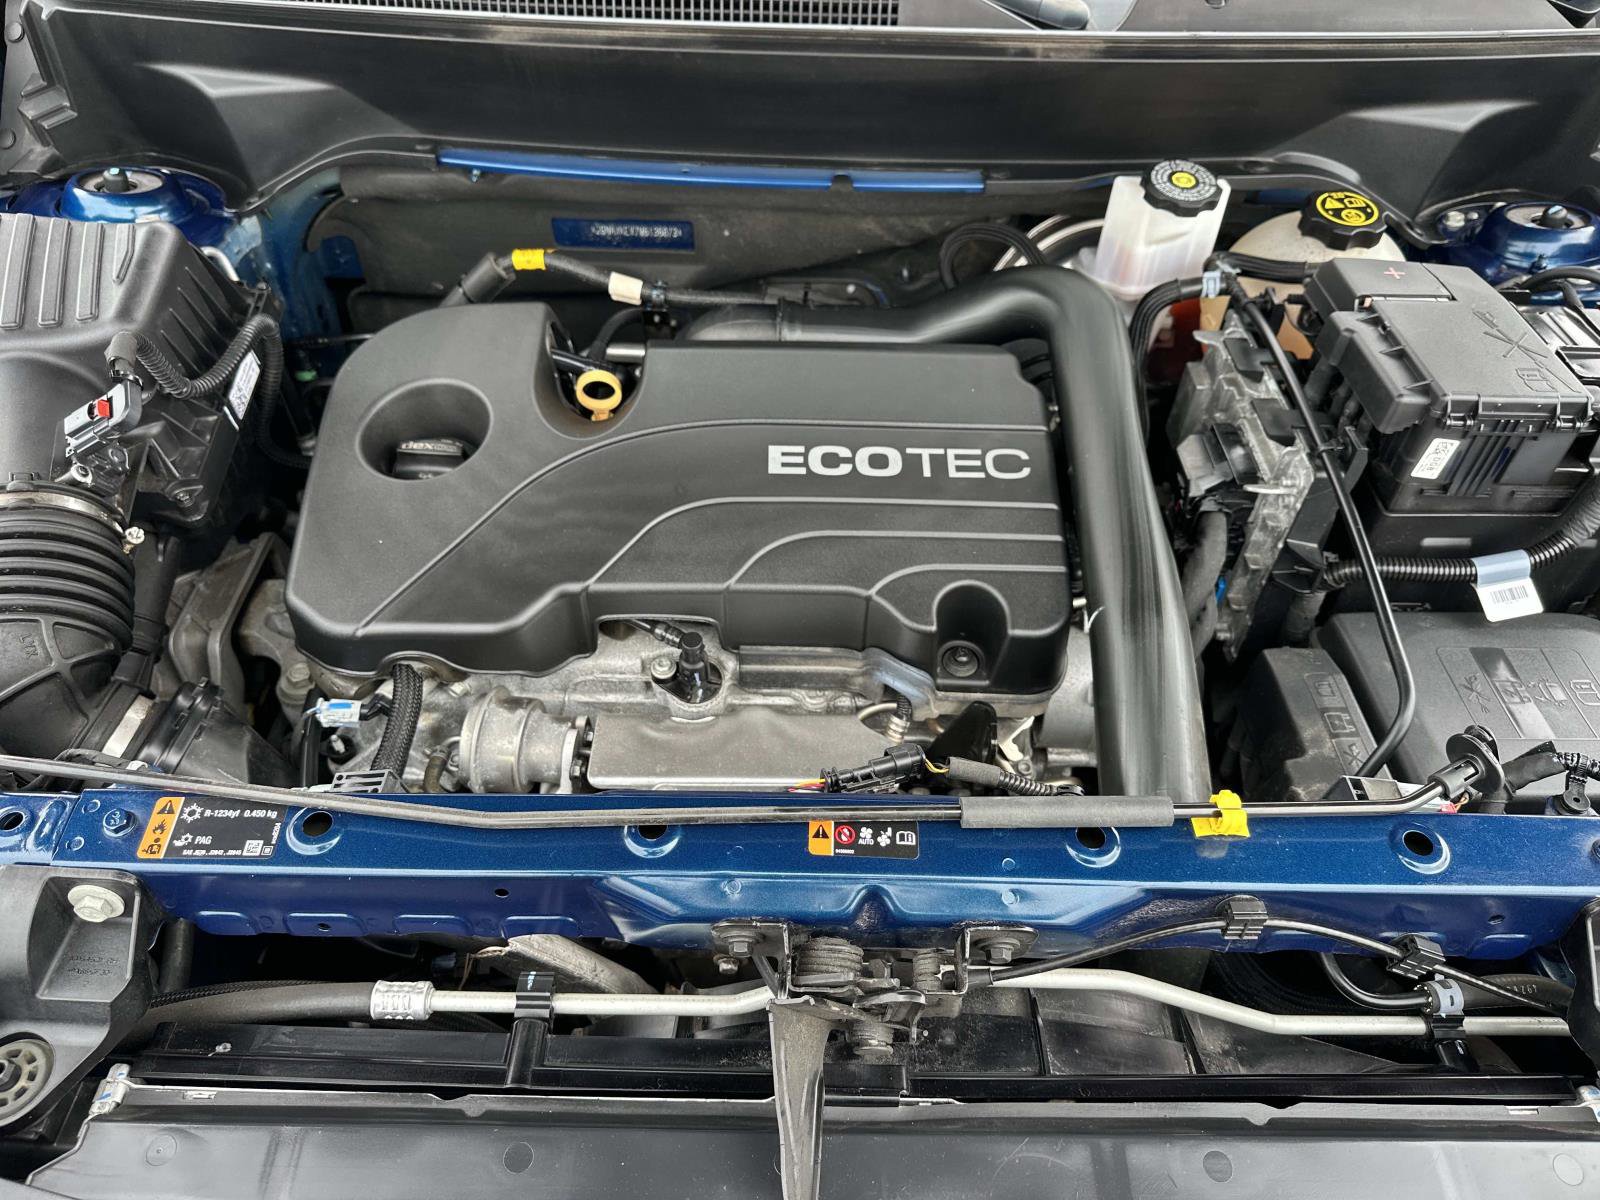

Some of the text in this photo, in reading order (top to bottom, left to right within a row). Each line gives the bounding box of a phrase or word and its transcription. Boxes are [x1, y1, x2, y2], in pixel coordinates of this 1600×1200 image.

[768, 445, 1031, 479] ECOTEC
[204, 809, 277, 819] R-1234yf 0.450 kg
[195, 836, 212, 844] PAG
